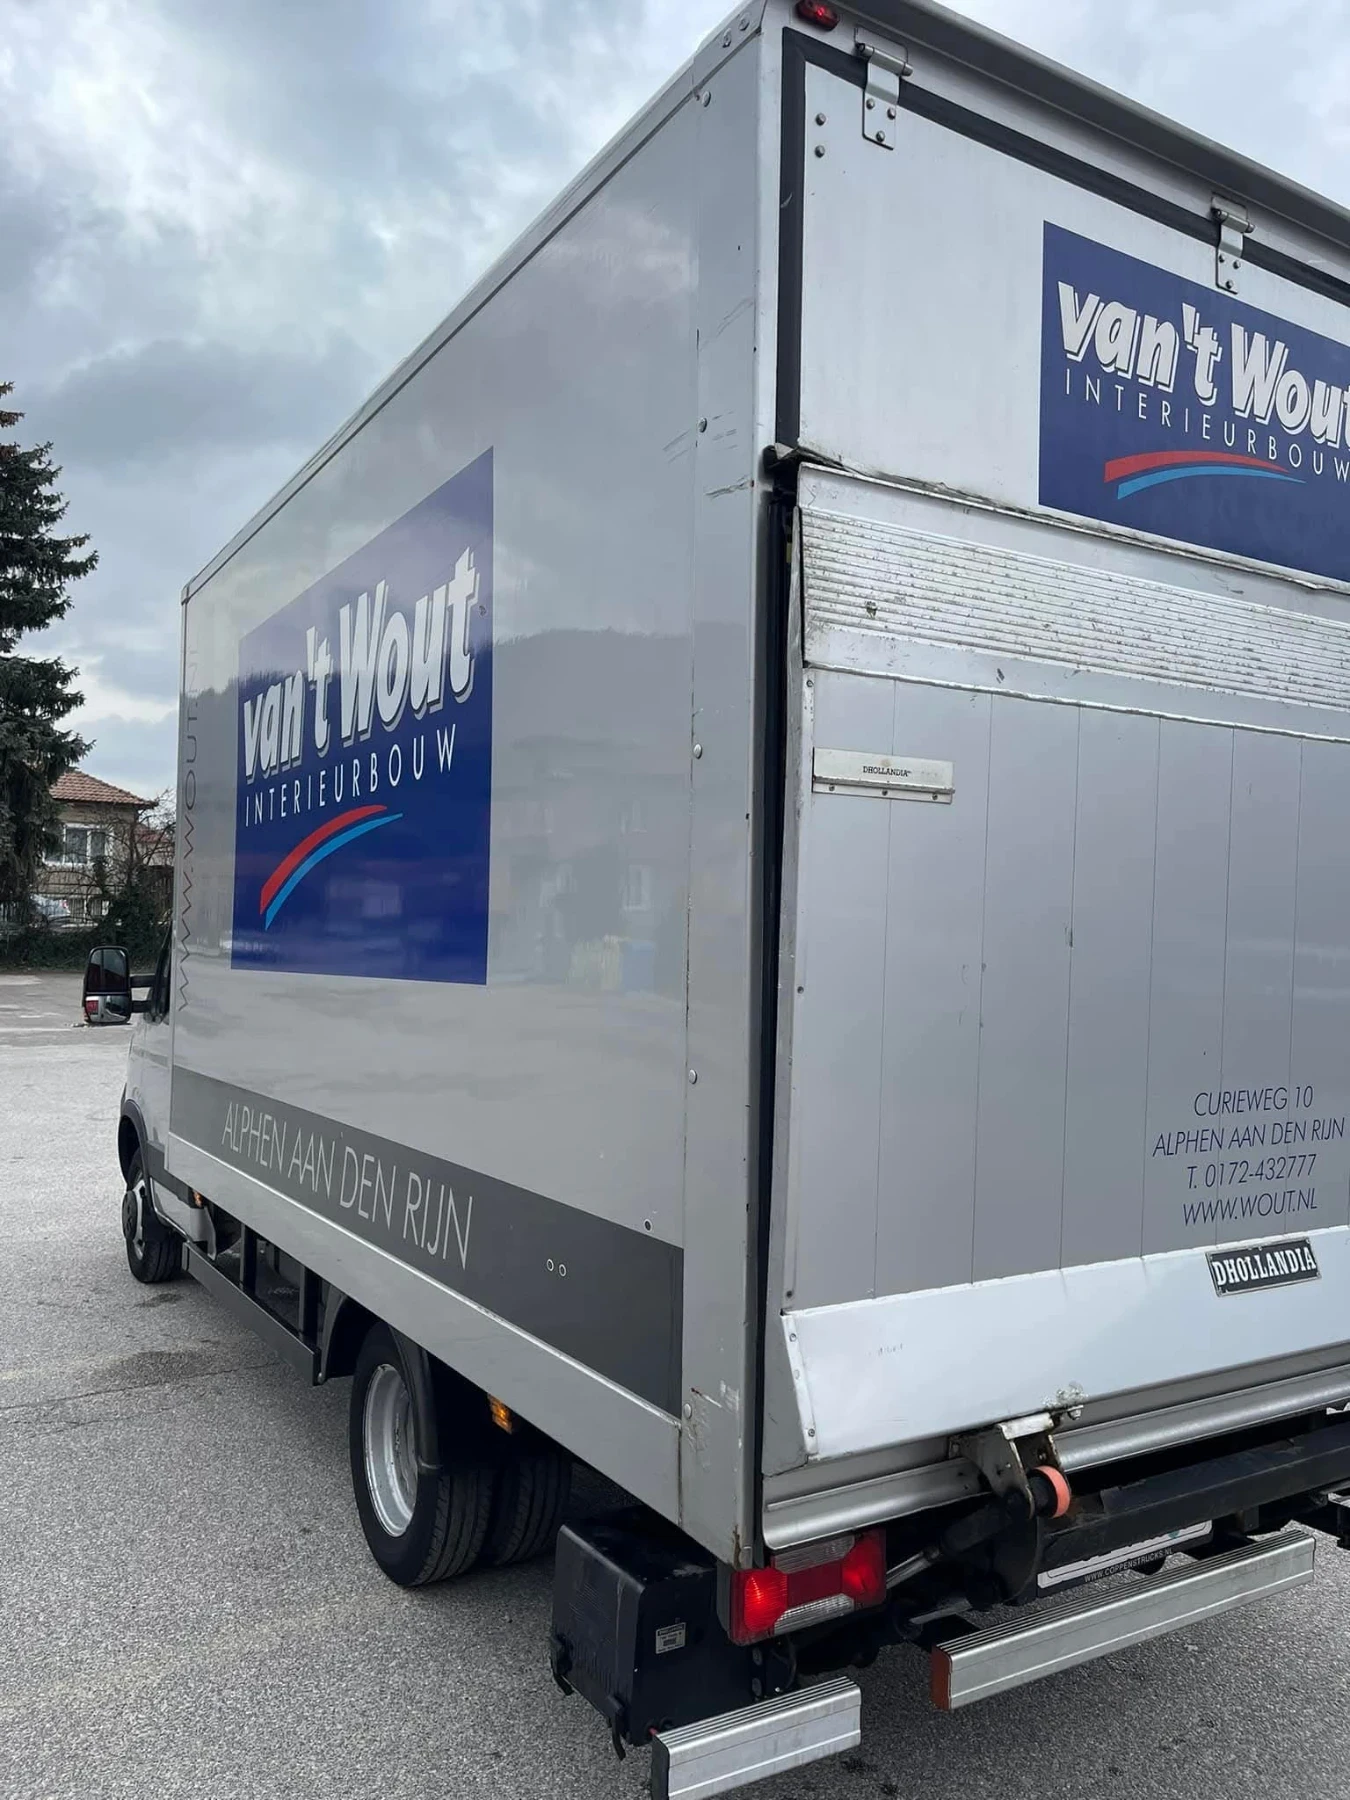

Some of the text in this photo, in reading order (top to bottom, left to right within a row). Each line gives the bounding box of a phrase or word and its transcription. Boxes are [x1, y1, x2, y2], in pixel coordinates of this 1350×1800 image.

[339, 546, 480, 747] Wout
[245, 723, 457, 827] INTERIEURBOUW
[1194, 1085, 1314, 1117] CURIEWEG 10
[1152, 1116, 1346, 1157] ALPHEN AAN DEN RIJN
[221, 1101, 474, 1271] ALPHEN AAN DEN RIJN
[1187, 1153, 1317, 1189] T. 0172-432777
[1183, 1187, 1318, 1227] WWW.WOUT.NL
[1211, 1246, 1317, 1286] DHOLLANDIA
